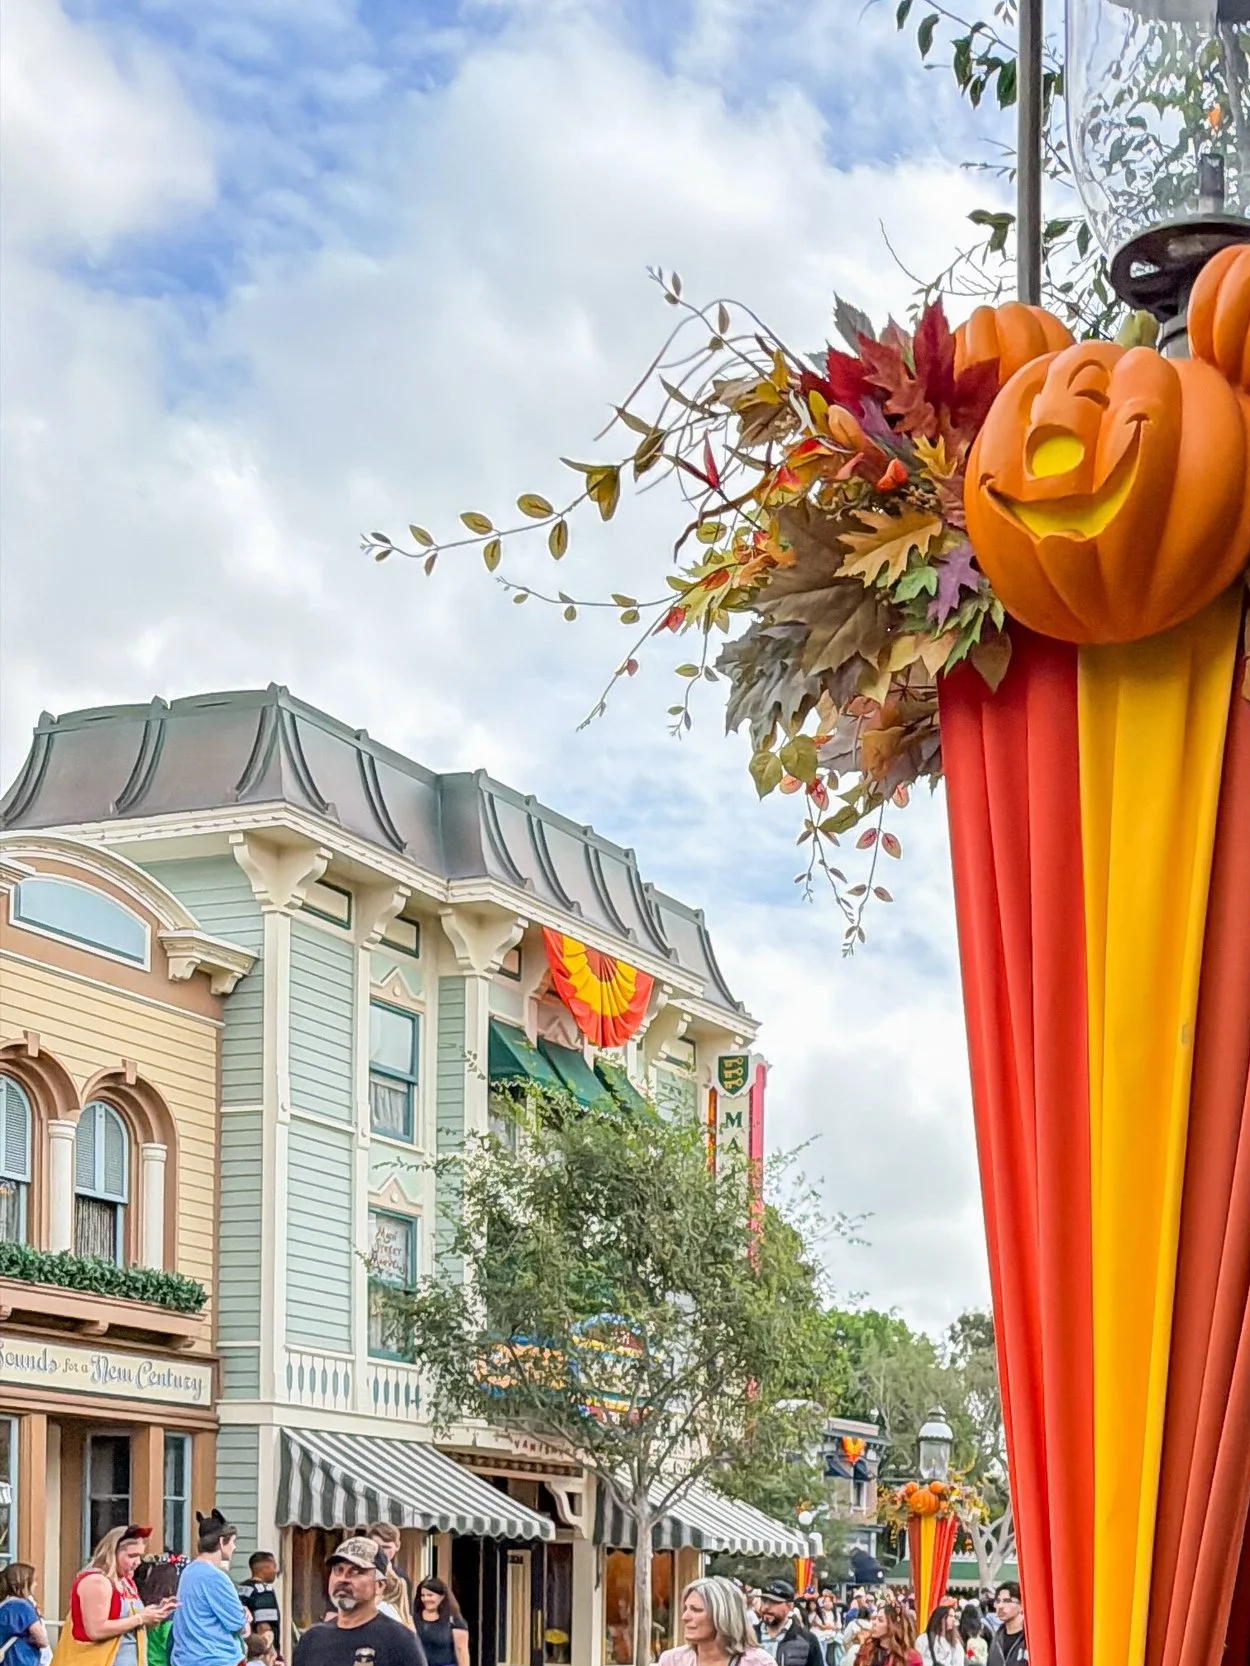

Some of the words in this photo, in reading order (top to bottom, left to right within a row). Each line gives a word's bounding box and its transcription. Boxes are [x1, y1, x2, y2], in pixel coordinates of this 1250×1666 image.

[62, 1357, 79, 1374] for
[81, 1363, 89, 1374] a
[90, 1353, 134, 1385] New
[135, 1360, 206, 1401] Century
